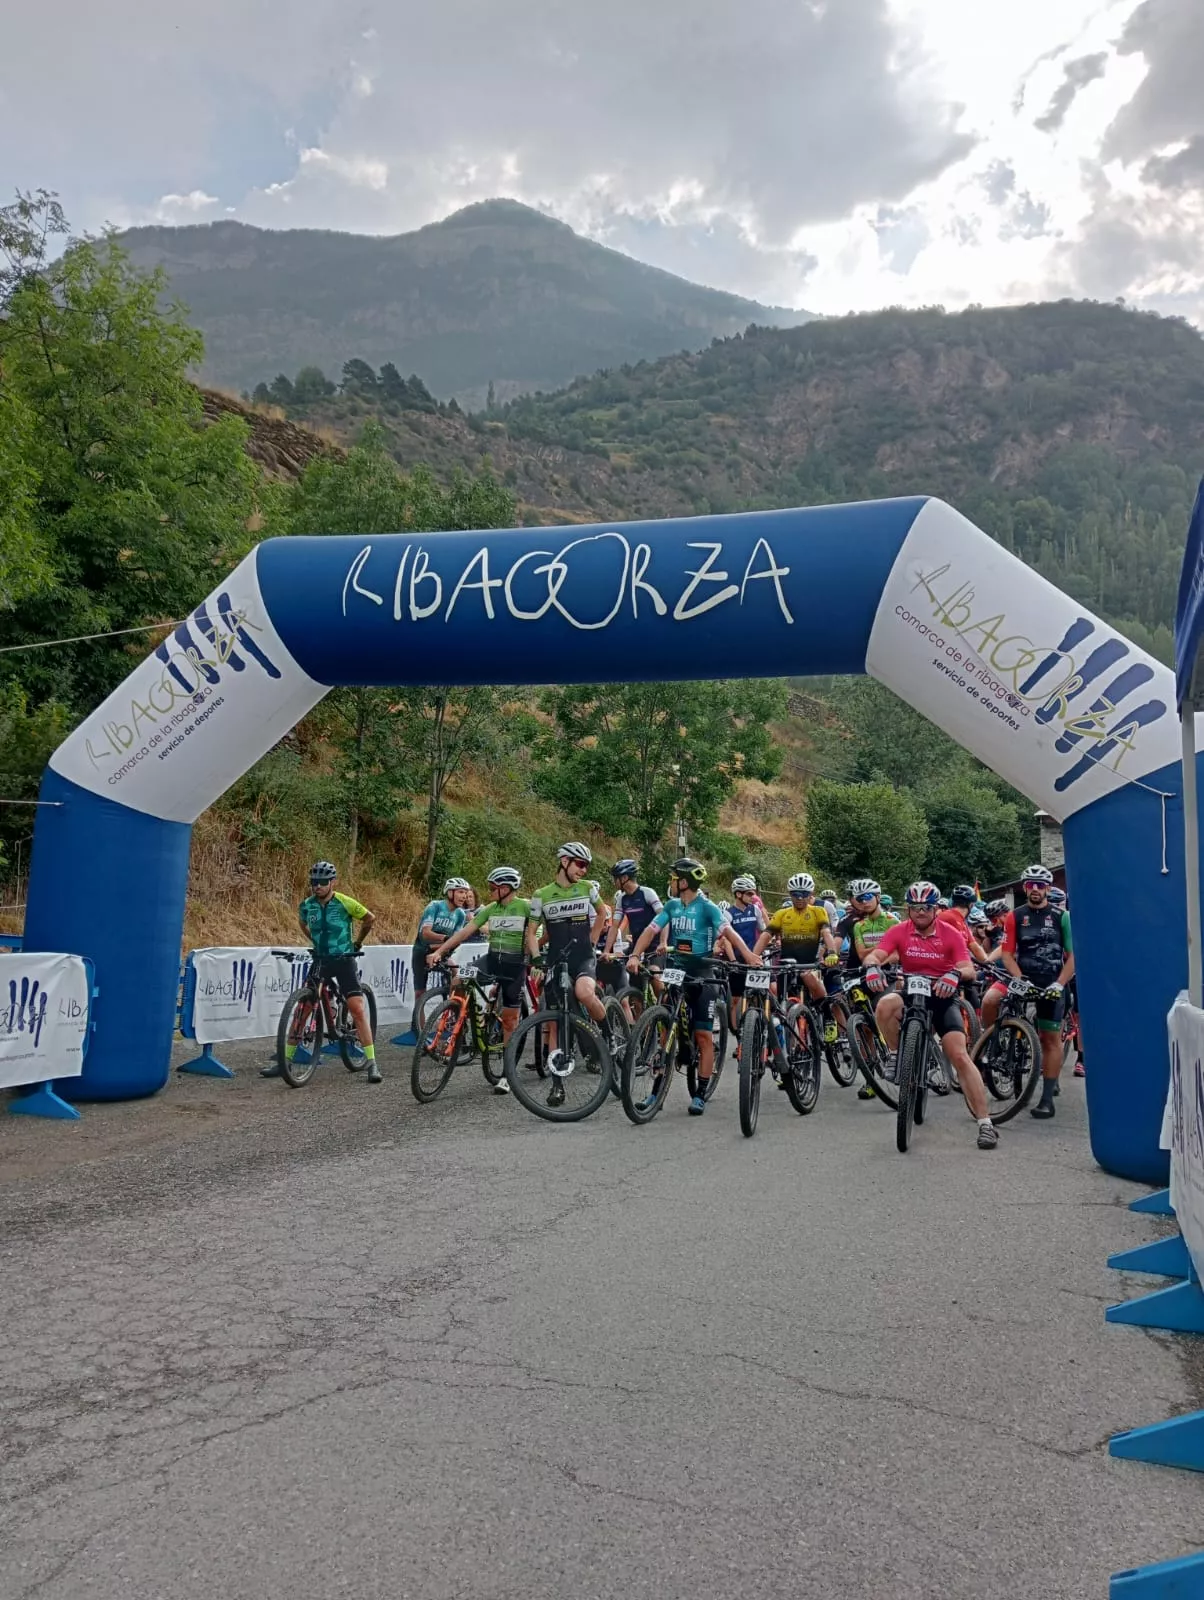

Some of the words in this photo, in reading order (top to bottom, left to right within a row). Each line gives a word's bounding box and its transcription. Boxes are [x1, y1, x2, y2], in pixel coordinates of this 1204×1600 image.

[342, 532, 793, 629] RIBAGORZA
[895, 605, 945, 648] comarca
[945, 647, 962, 662] de
[962, 657, 976, 672] la
[932, 658, 967, 687] servicio
[966, 685, 980, 698] de
[980, 697, 1021, 731] deportes
[108, 746, 150, 785] comarca
[148, 733, 163, 749] de
[160, 724, 172, 736] la
[171, 686, 213, 727] ribagza
[158, 734, 185, 760] servicio
[184, 724, 195, 736] de
[194, 696, 225, 726] deportes
[559, 902, 585, 912] MAPEI
[671, 915, 697, 931] PEDAL
[459, 968, 475, 977] 659
[748, 974, 767, 983] 677
[910, 980, 929, 991] 694
